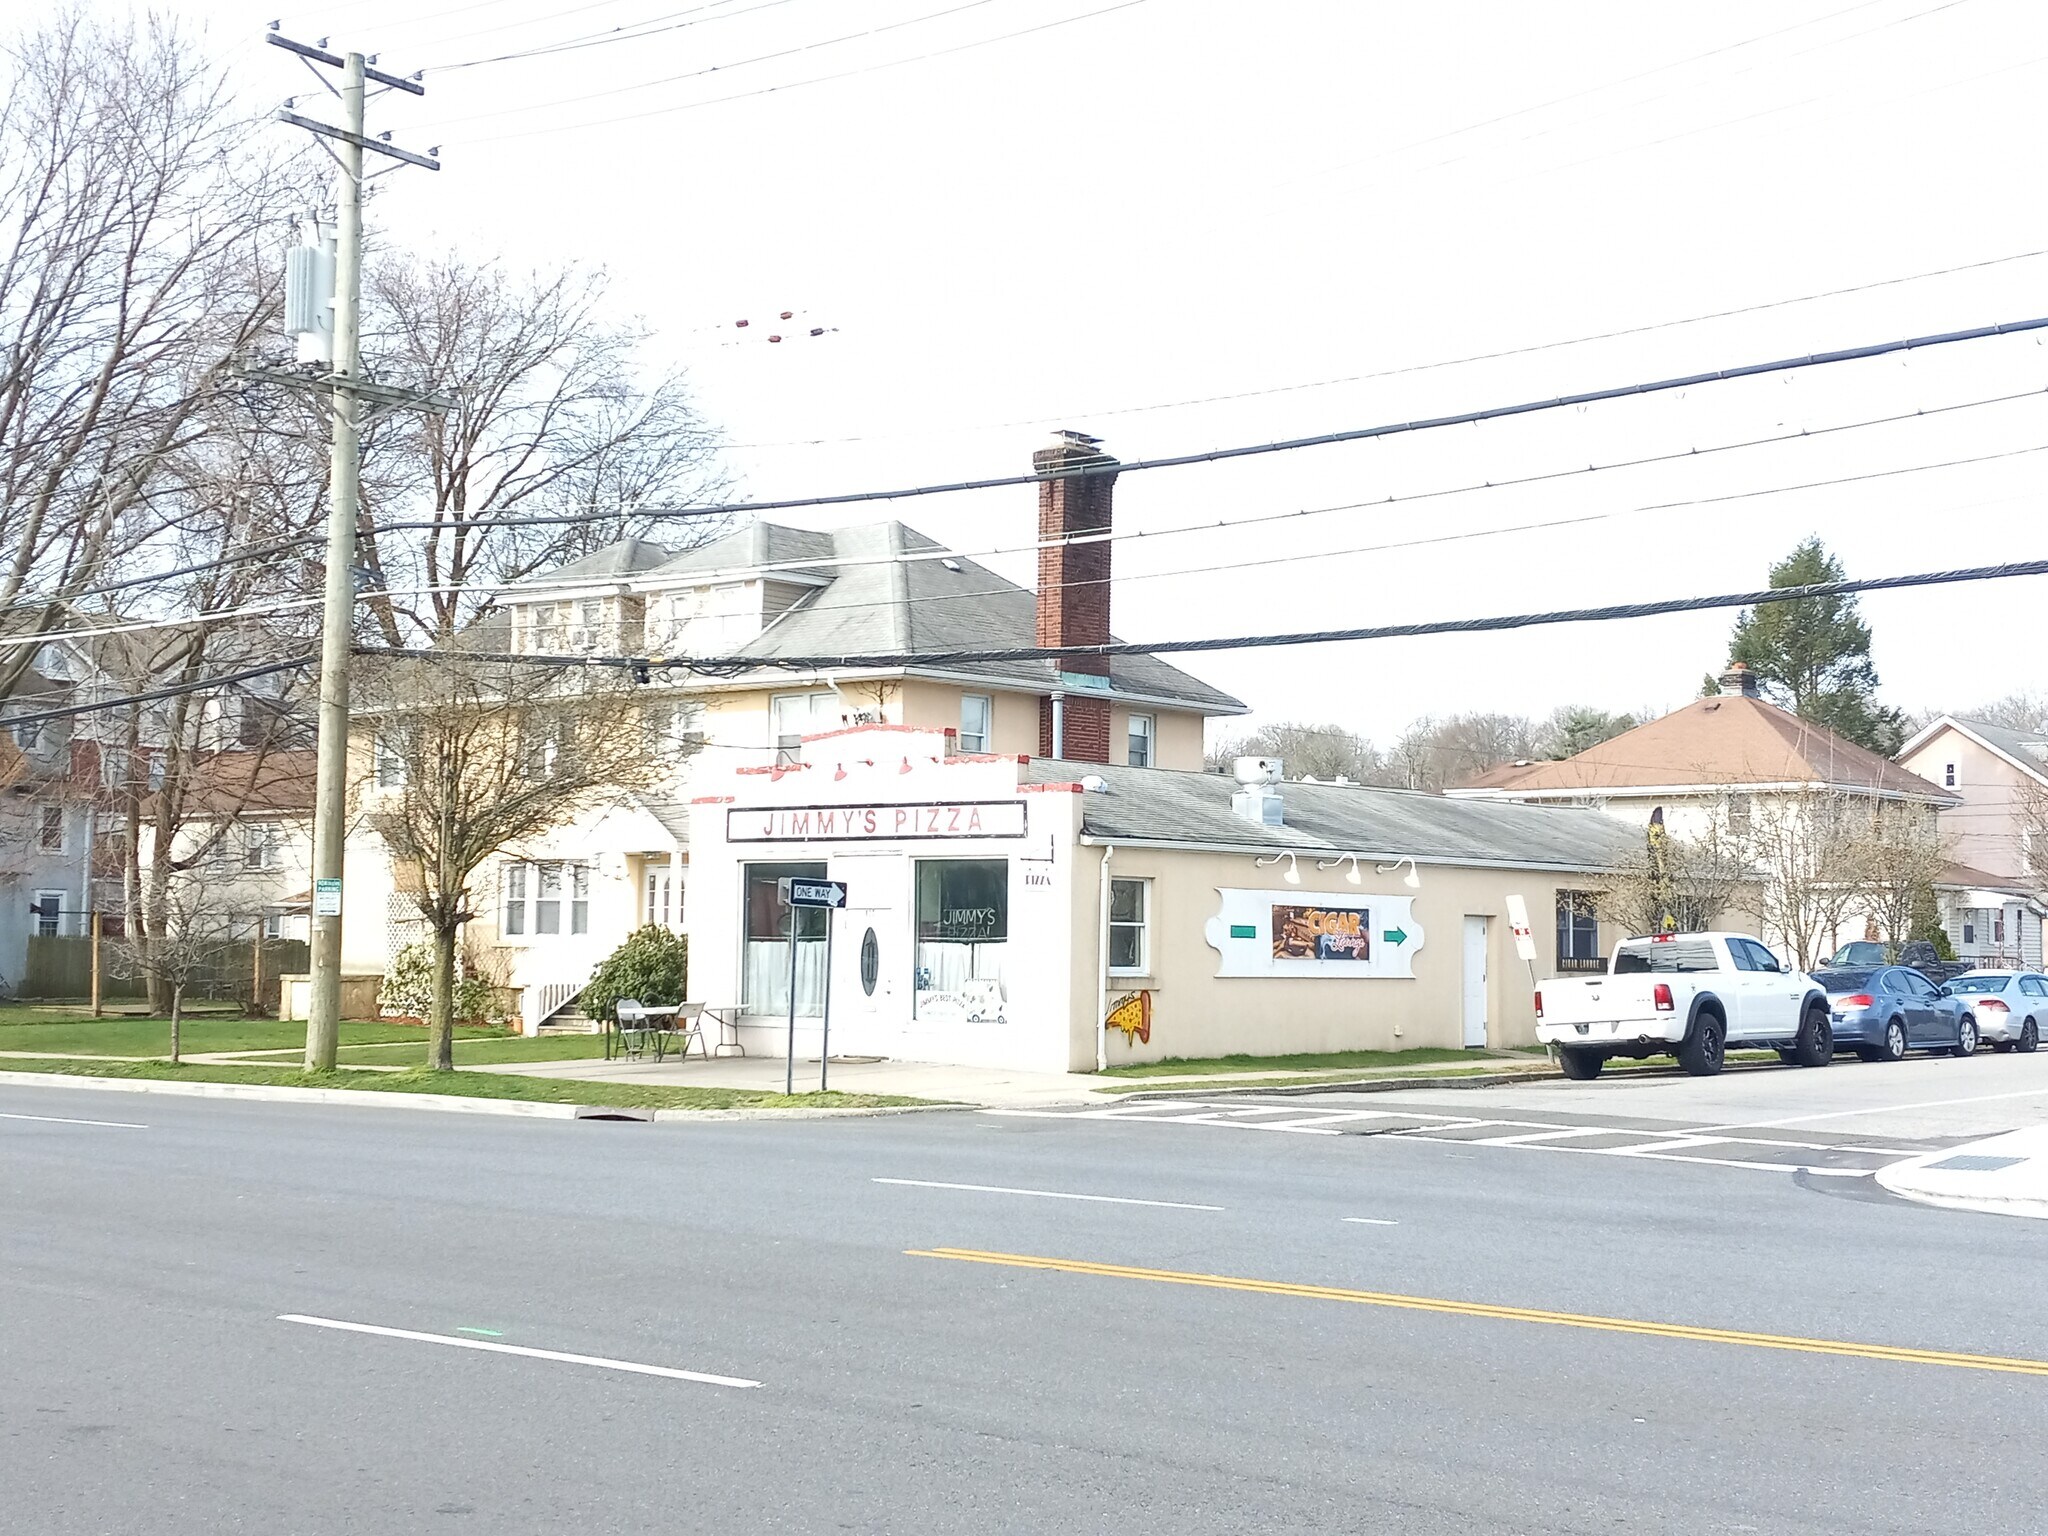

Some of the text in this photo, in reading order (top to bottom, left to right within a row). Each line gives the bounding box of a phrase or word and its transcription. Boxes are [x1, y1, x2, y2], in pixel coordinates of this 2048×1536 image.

[763, 807, 982, 836] JIMMY'S PIZZA
[796, 886, 831, 899] ONE WAY
[1308, 910, 1361, 936] CIGAR
